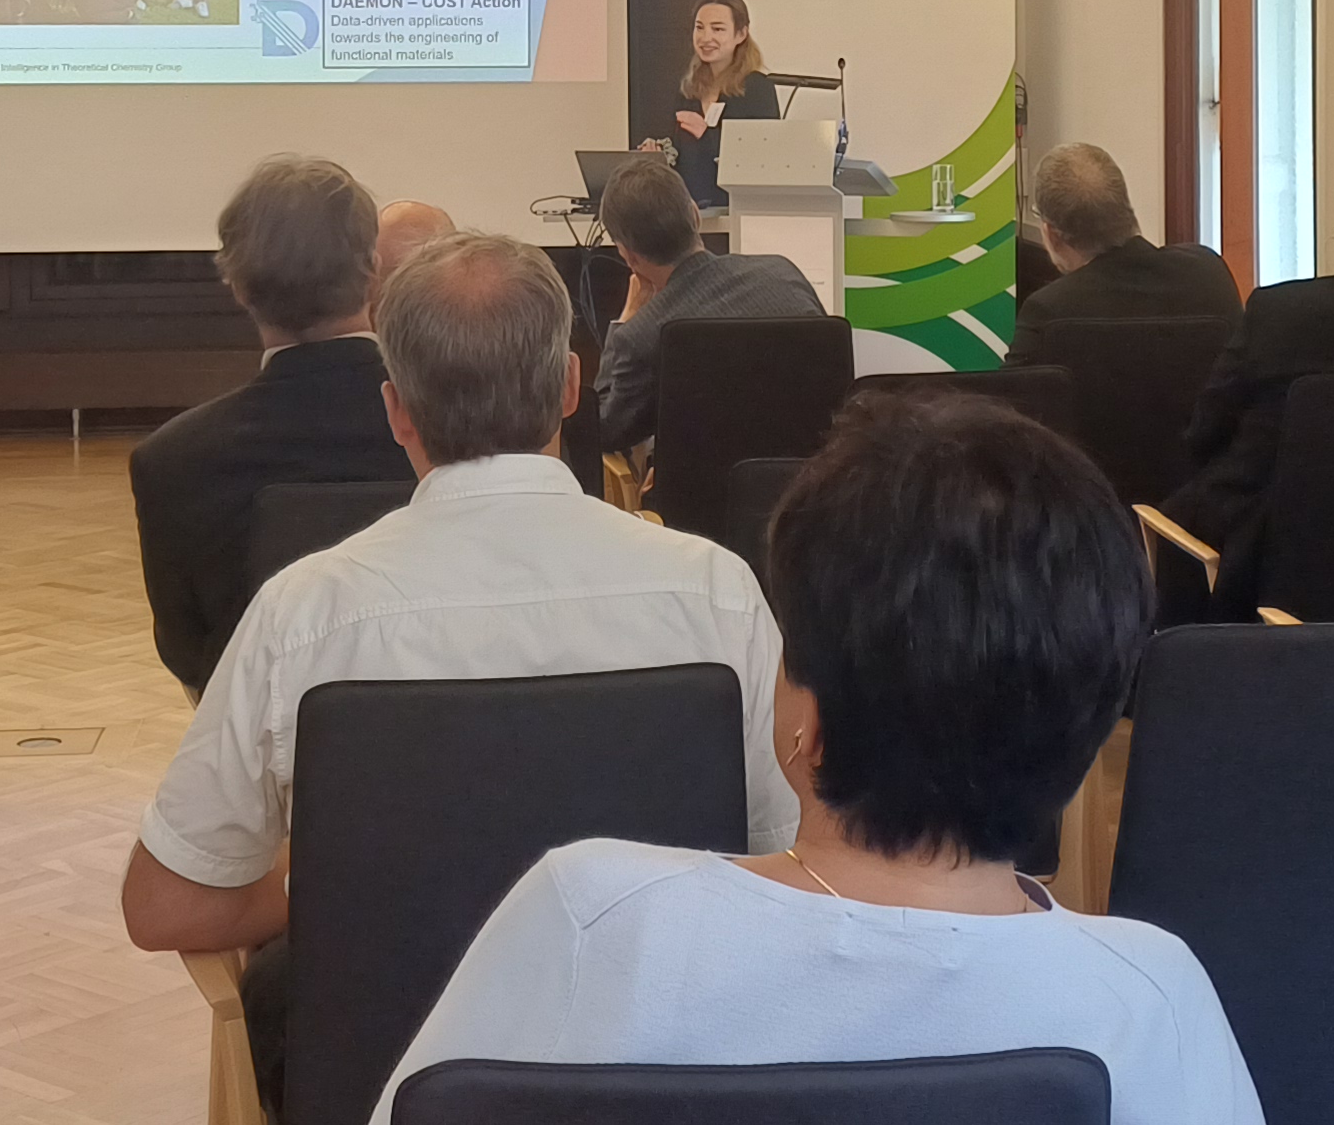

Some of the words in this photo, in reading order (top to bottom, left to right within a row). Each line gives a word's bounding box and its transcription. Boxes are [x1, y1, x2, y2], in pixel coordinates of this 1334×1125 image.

[331, 15, 405, 27] Data-driven
[408, 15, 484, 30] applications
[331, 32, 382, 44] towards
[385, 31, 405, 44] the
[408, 32, 483, 47] engineering
[486, 31, 500, 44] of
[331, 48, 393, 61] functional
[396, 48, 454, 61] materials
[1, 63, 49, 74] Intelligence
[51, 63, 59, 72] in
[61, 63, 109, 72] Theoretical
[111, 63, 154, 74] Chemistry
[156, 63, 183, 73] Group
